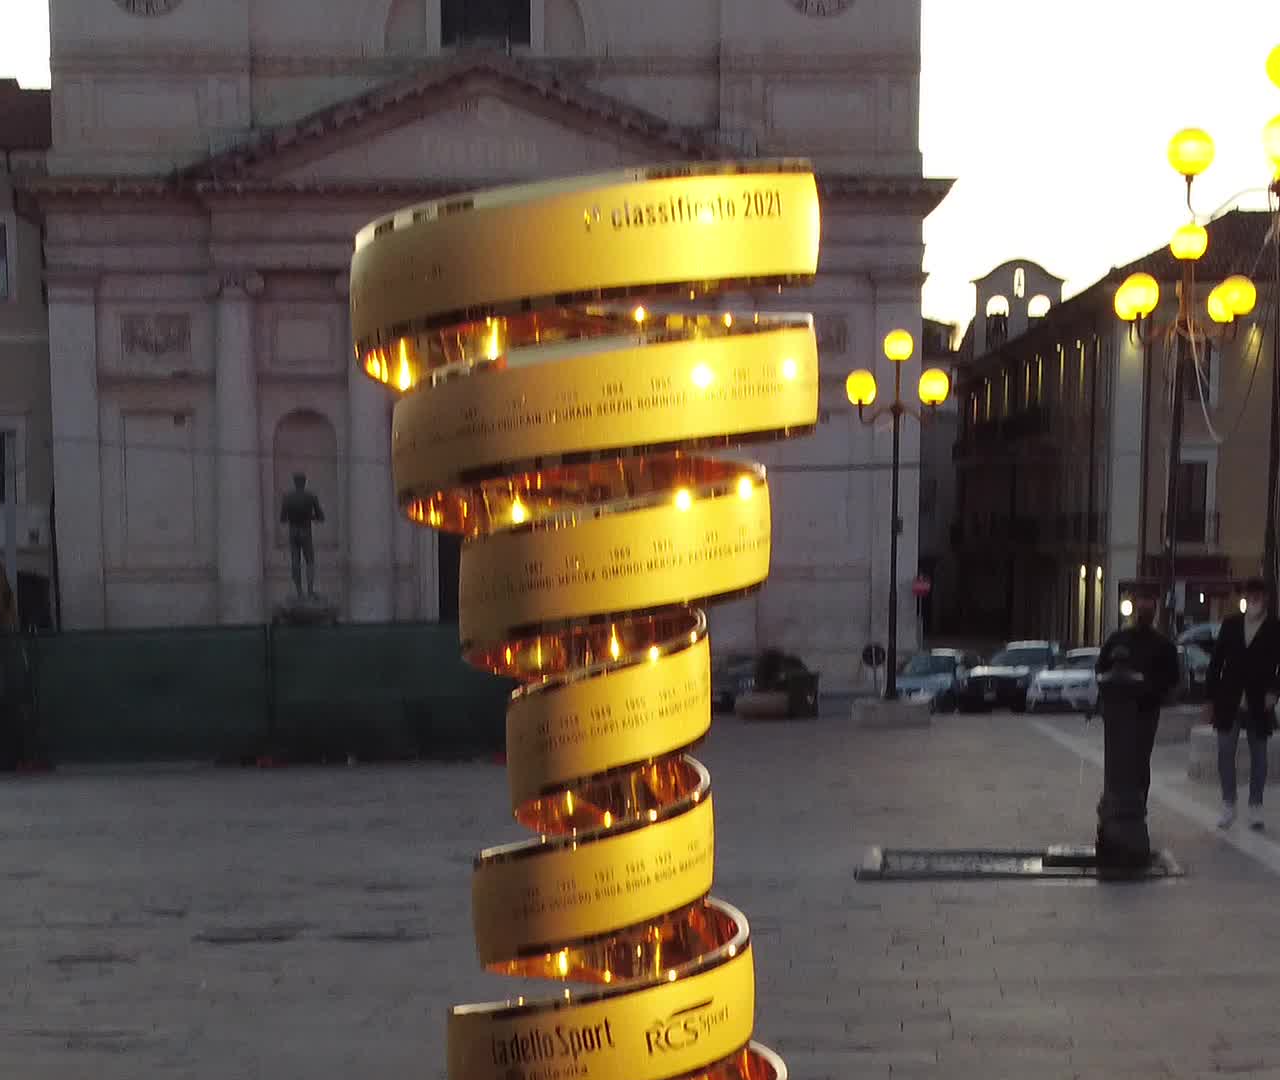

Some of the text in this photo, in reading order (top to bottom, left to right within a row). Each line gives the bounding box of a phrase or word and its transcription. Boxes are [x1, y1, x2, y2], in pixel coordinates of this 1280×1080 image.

[743, 189, 782, 217] 2021
[555, 1016, 616, 1062] Sport
[645, 1018, 699, 1057] RCS
